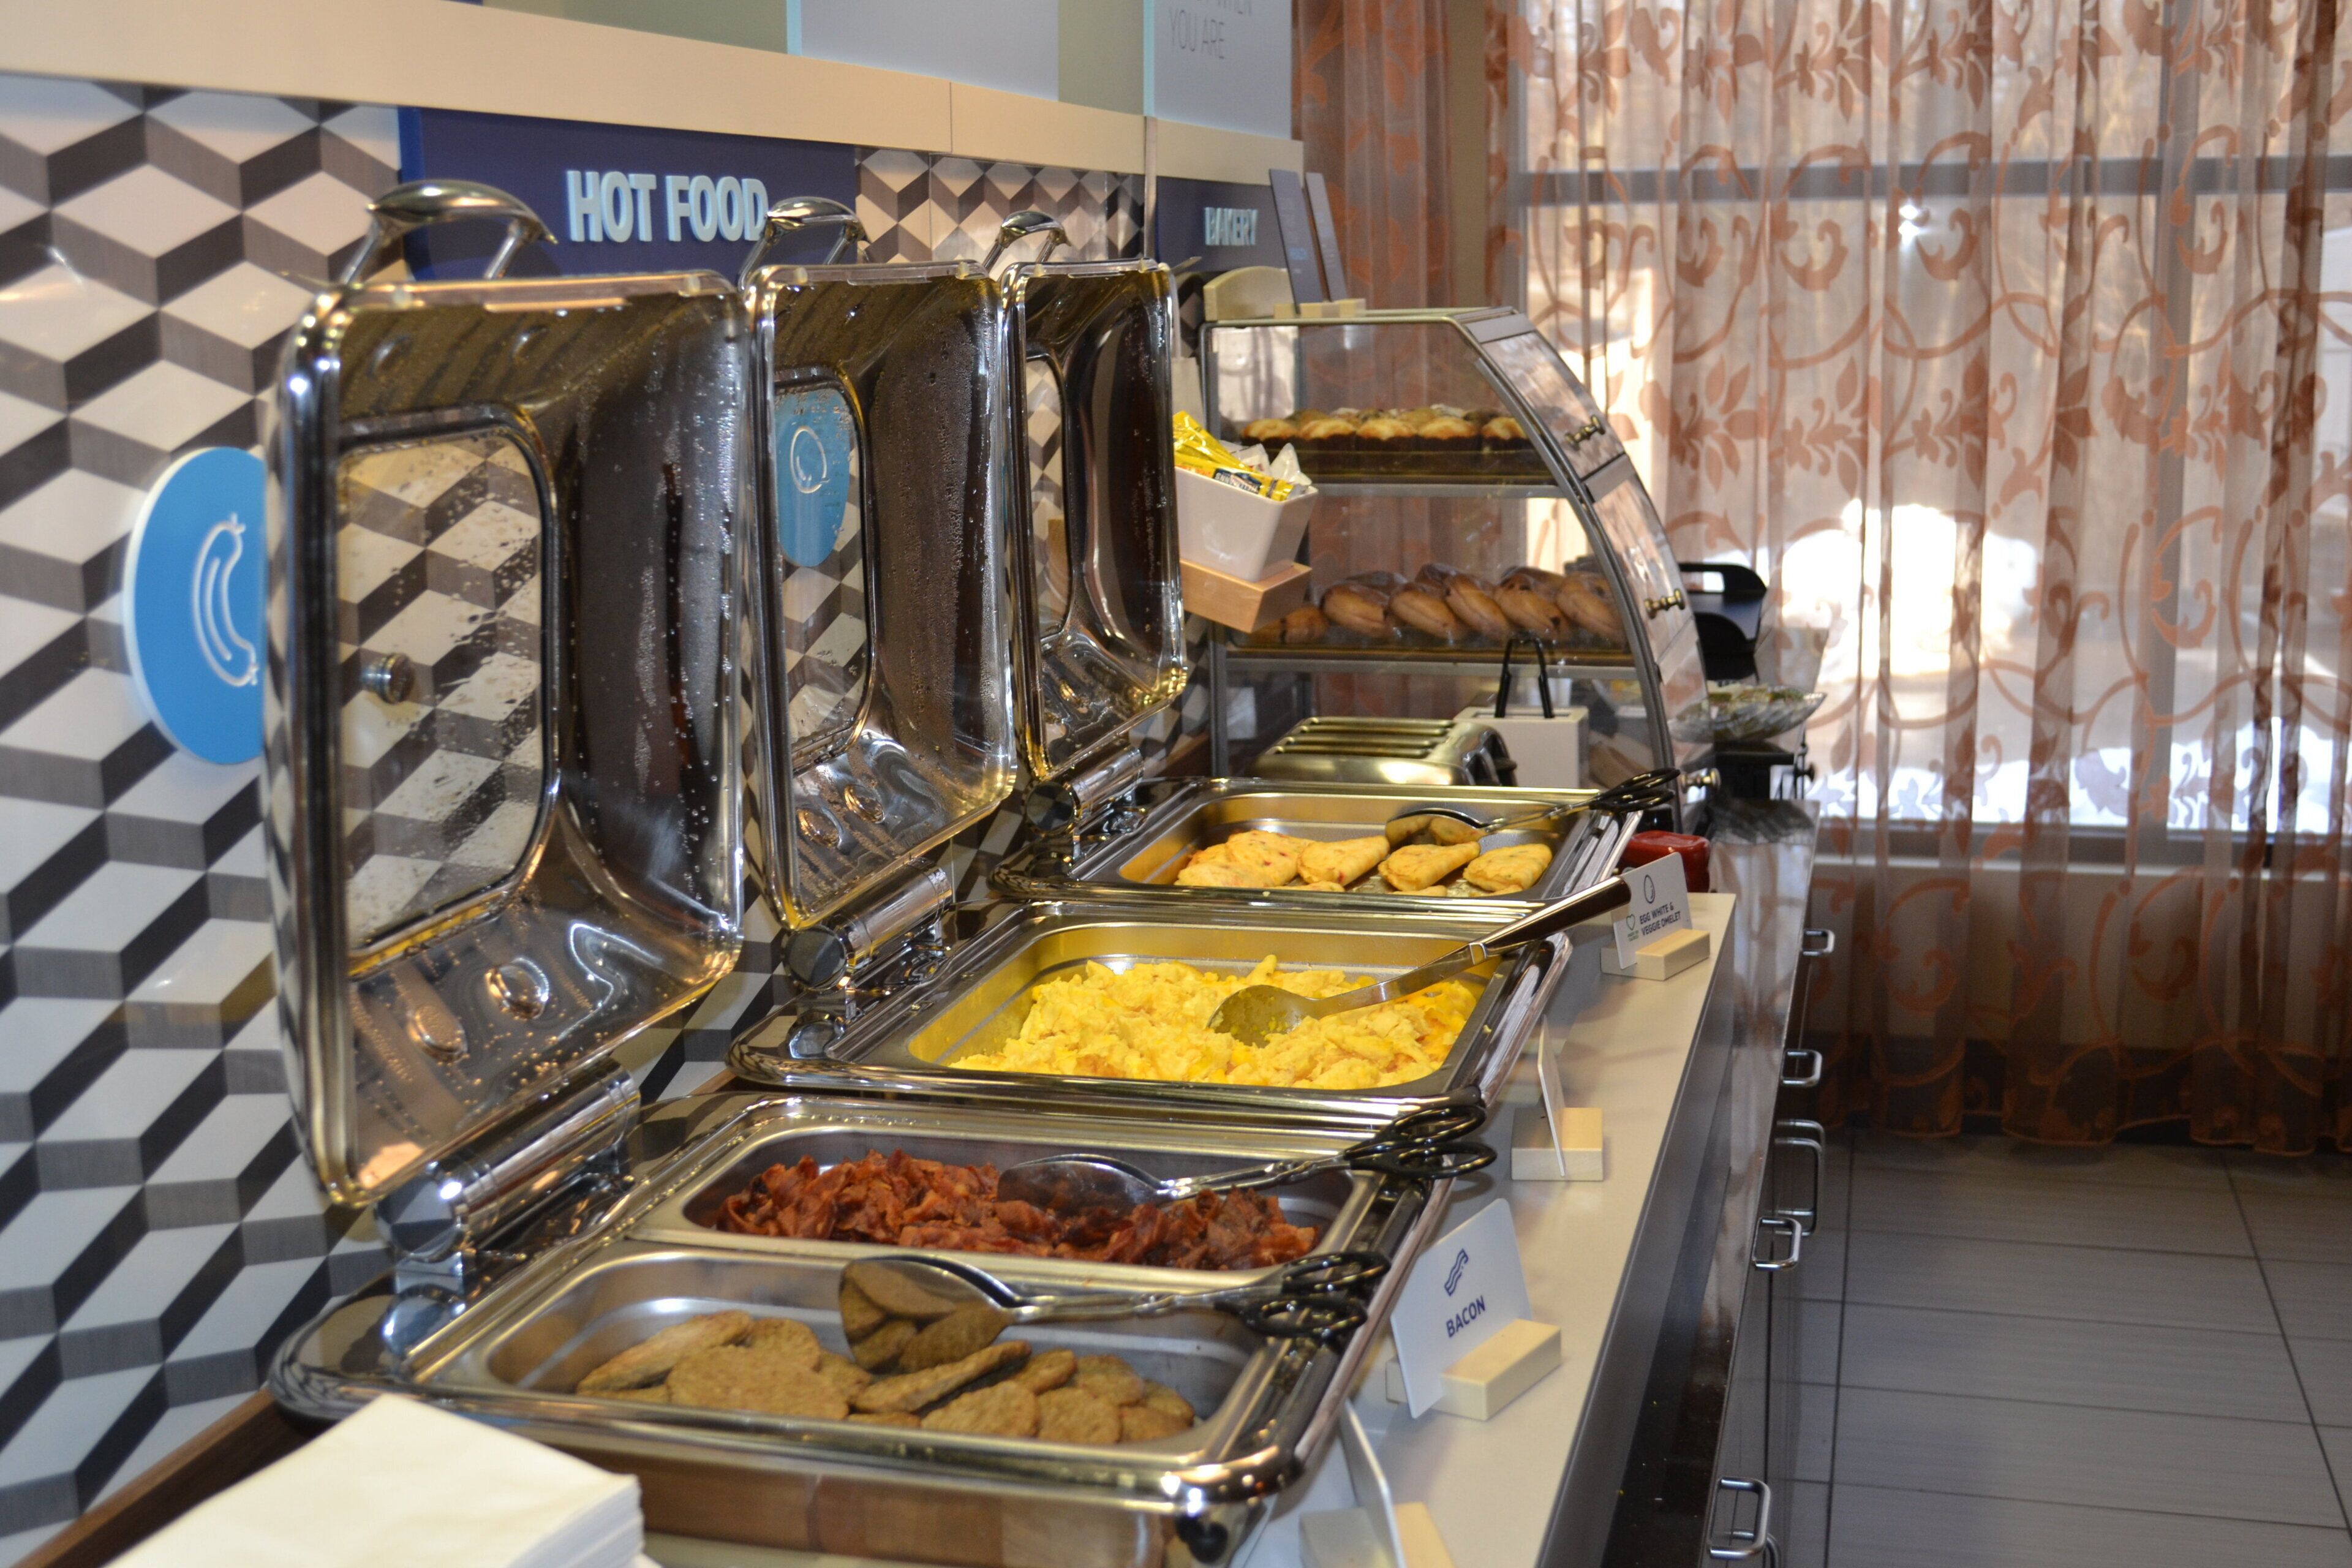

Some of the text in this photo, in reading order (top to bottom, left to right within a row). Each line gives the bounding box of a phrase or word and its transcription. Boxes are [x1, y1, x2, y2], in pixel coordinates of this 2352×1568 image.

[1169, 7, 1225, 59] YOU ARE
[566, 170, 769, 243] HOT FOOD
[1204, 206, 1258, 246] BAKERY
[1639, 902, 1674, 925] EGG WHITE &
[1641, 920, 1661, 936] VEGGIE
[1661, 910, 1681, 927] OMELET
[1446, 1294, 1486, 1338] BACON
